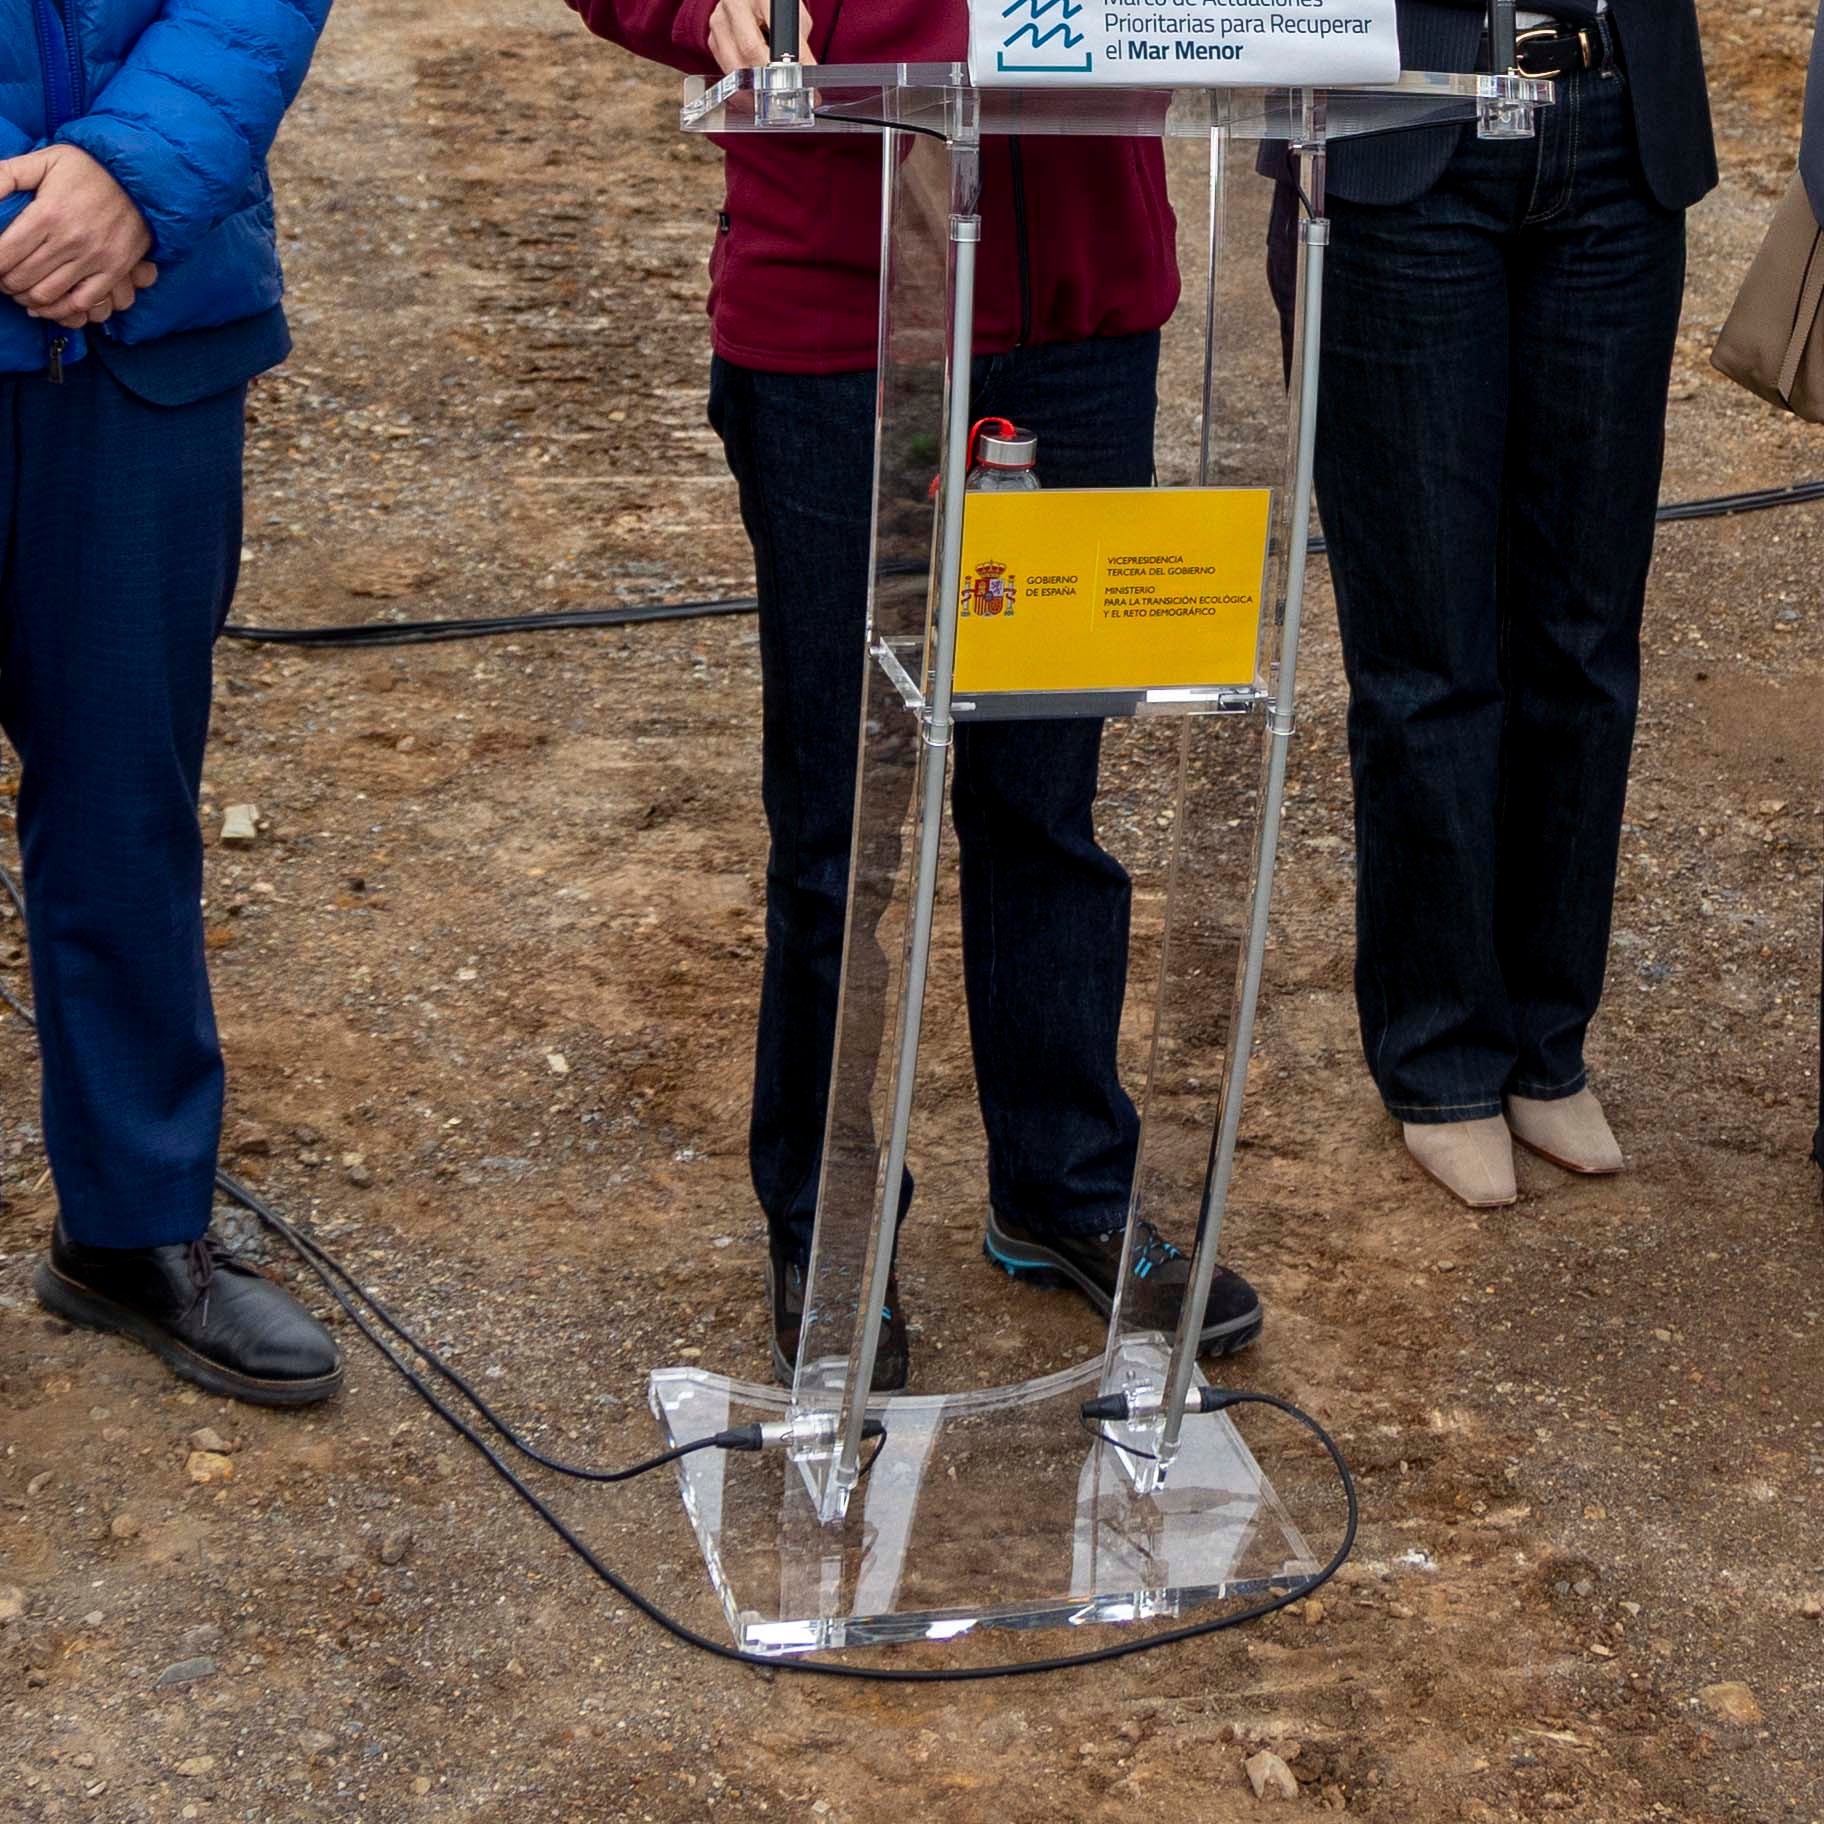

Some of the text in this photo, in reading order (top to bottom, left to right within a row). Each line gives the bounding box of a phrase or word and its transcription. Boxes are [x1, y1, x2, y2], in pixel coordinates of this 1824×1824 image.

[1104, 11, 1373, 39] Prioritarias para Recuperar
[1105, 40, 1244, 61] el Mar Menor
[1107, 555, 1184, 565] VICEPRESIDENCIA
[1107, 565, 1216, 576] TERCERA DEL GOBIERNO
[1026, 575, 1078, 586] GOBIERNO
[1025, 585, 1077, 598] DE ESPAÑA
[1104, 585, 1156, 595] MINISTERIO
[1104, 593, 1254, 607] PARA LA TRANSICIÓN ECOLÓGICA
[1103, 605, 1217, 619] Y EL RETO DEMOGRÁFICO
